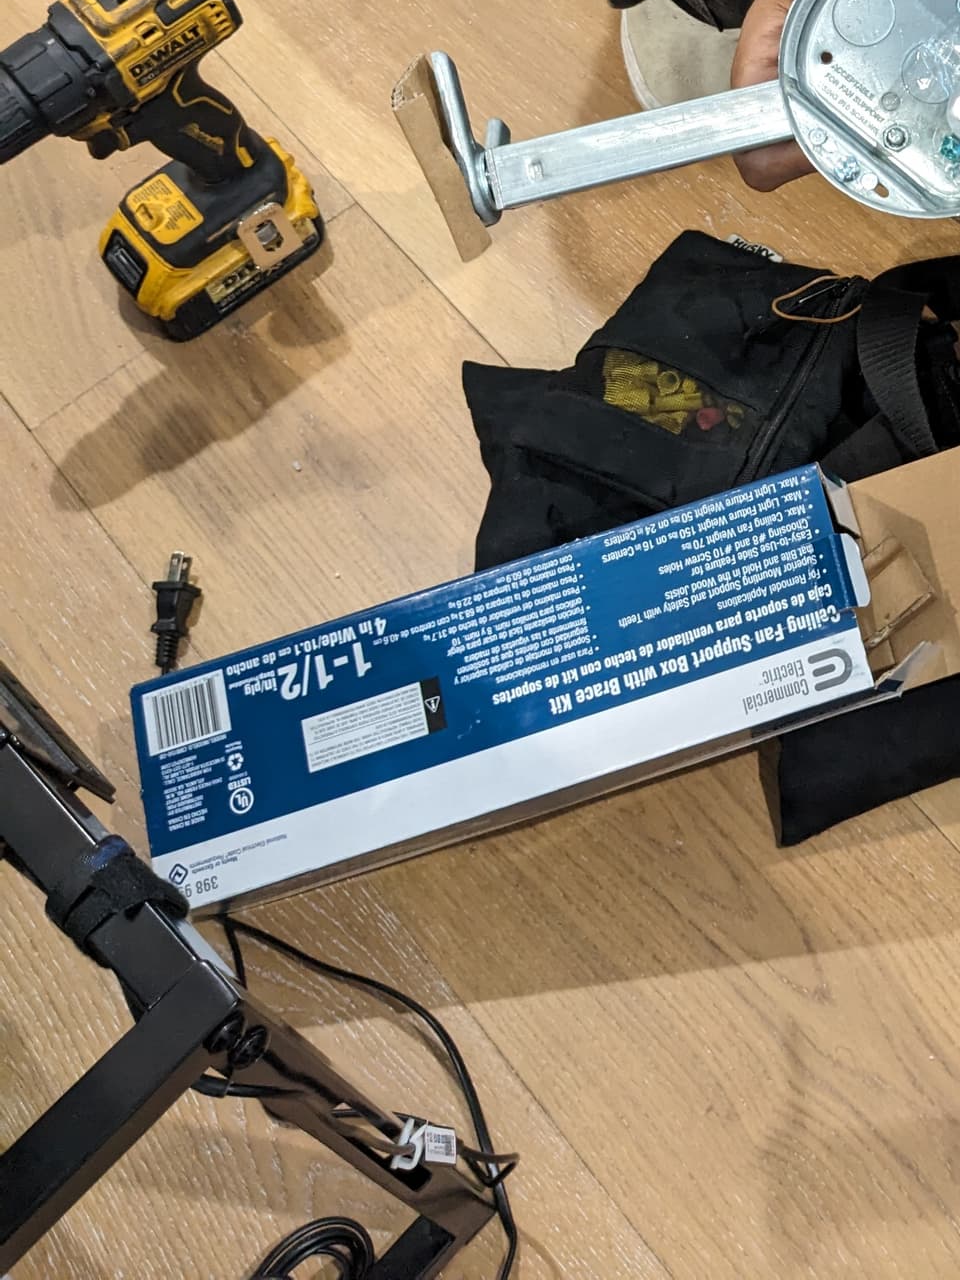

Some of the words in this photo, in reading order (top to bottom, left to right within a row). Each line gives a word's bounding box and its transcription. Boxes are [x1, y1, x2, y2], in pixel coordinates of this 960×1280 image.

[831, 64, 875, 101] ACCEPTABLE
[824, 73, 840, 85] FOR
[838, 84, 855, 98] FAN
[851, 96, 885, 123] SUPPORT
[777, 476, 798, 488] Max.
[753, 483, 776, 498] Light
[781, 490, 802, 502] Max.
[725, 491, 753, 506] Fixture
[757, 497, 779, 512] Light
[693, 501, 724, 517] Weight
[728, 505, 757, 520] Fixture
[784, 503, 805, 516] Max.
[657, 518, 669, 529] on
[680, 511, 693, 523] 50
[697, 515, 727, 532] Weight
[753, 511, 783, 527] Ceiling
[644, 523, 656, 535] 24
[678, 525, 696, 539] 150
[736, 521, 753, 533] Fan
[767, 517, 808, 537] Choosing
[603, 528, 636, 546] Centers
[655, 534, 667, 545] on
[705, 527, 736, 544] Weight
[752, 532, 766, 545] #8
[760, 529, 812, 552] Easy-to-Use
[642, 539, 654, 551] 16
[692, 537, 705, 549] 70
[734, 537, 750, 551] and
[797, 543, 813, 556] that
[601, 546, 634, 562] Centers
[712, 543, 731, 558] #10
[737, 546, 758, 560] Slide
[780, 549, 797, 561] Bite
[532, 558, 558, 572] centros
[558, 554, 572, 563] con
[684, 550, 711, 566] Screw
[704, 554, 736, 570] Feature
[762, 555, 779, 568] and
[783, 554, 817, 572] Superior
[522, 567, 532, 576] de
[556, 562, 575, 573] Peso
[658, 560, 683, 574] Holes
[691, 565, 703, 576] for
[731, 568, 741, 577] in
[741, 561, 762, 576] Hold
[807, 568, 820, 579] For
[505, 570, 522, 583] 60.9
[518, 577, 528, 586] de
[528, 569, 556, 583] máximo
[559, 574, 577, 585] Peso
[717, 571, 731, 582] the
[742, 566, 781, 585] Mounting
[482, 581, 510, 598] lámpara
[510, 579, 518, 589] la
[531, 580, 558, 594] máximo
[561, 585, 580, 596] Peso
[690, 576, 716, 592] Wood
[707, 580, 741, 598] Support
[768, 573, 806, 594] Remodel
[472, 593, 482, 601] de
[513, 592, 521, 600] la
[521, 589, 530, 598] de
[533, 591, 561, 605] máximo
[664, 584, 689, 602] Joists
[690, 591, 706, 605] and
[716, 586, 766, 609] Applications
[790, 592, 805, 606] de
[807, 583, 831, 601] Caja
[455, 596, 472, 608] 22.6
[475, 604, 484, 613] de
[485, 595, 513, 609] lámpara
[521, 600, 533, 611] del
[663, 597, 689, 612] Safety
[457, 607, 474, 620] 68.3
[488, 605, 521, 621] ventilador
[557, 605, 584, 619] Función
[643, 606, 661, 619] with
[745, 599, 788, 621] soporte
[436, 615, 450, 625] con
[457, 619, 477, 631] techo
[478, 615, 487, 624] de
[523, 614, 556, 630] deslizante
[618, 613, 642, 627] Teeth
[715, 611, 742, 631] para
[786, 605, 840, 632] Ceiling
[358, 620, 372, 634] in
[374, 617, 386, 635] 4
[399, 629, 409, 637] de
[409, 620, 435, 634] centros
[447, 625, 457, 634] de
[508, 625, 523, 637] fácil
[754, 623, 784, 643] Fan
[294, 626, 355, 657] Wide/10.1
[382, 633, 399, 644] 40.6
[431, 628, 447, 641] 31.7
[482, 633, 497, 644] usar
[498, 630, 507, 639] de
[563, 634, 590, 648] Soporte
[656, 624, 713, 650] ventilador
[447, 643, 465, 656] elegir
[465, 637, 481, 649] para
[553, 643, 562, 652] de
[638, 643, 653, 657] de
[262, 651, 276, 664] de
[524, 647, 552, 661] montaje
[560, 651, 576, 662] usar
[576, 646, 593, 656] Para
[691, 634, 751, 667] Support
[514, 656, 524, 665] de
[549, 657, 559, 665] en
[604, 649, 636, 667] techo
[659, 655, 688, 675] Box
[226, 657, 259, 675] ancho
[277, 641, 372, 699] 1-1/2
[488, 659, 513, 674] calidad
[495, 661, 549, 683] remodelaciones
[579, 660, 601, 675] con
[454, 675, 459, 684] y
[460, 668, 488, 682] superior
[544, 674, 559, 688] de
[561, 668, 578, 684] kit
[623, 665, 657, 689] with
[244, 675, 276, 695] in/plg
[492, 680, 542, 704] soportes
[575, 677, 620, 702] Brace
[742, 678, 808, 714] Commercial
[549, 693, 572, 714] Kit
[227, 776, 251, 790] LISTED
[233, 790, 249, 810] UL
[195, 875, 218, 893] 398
